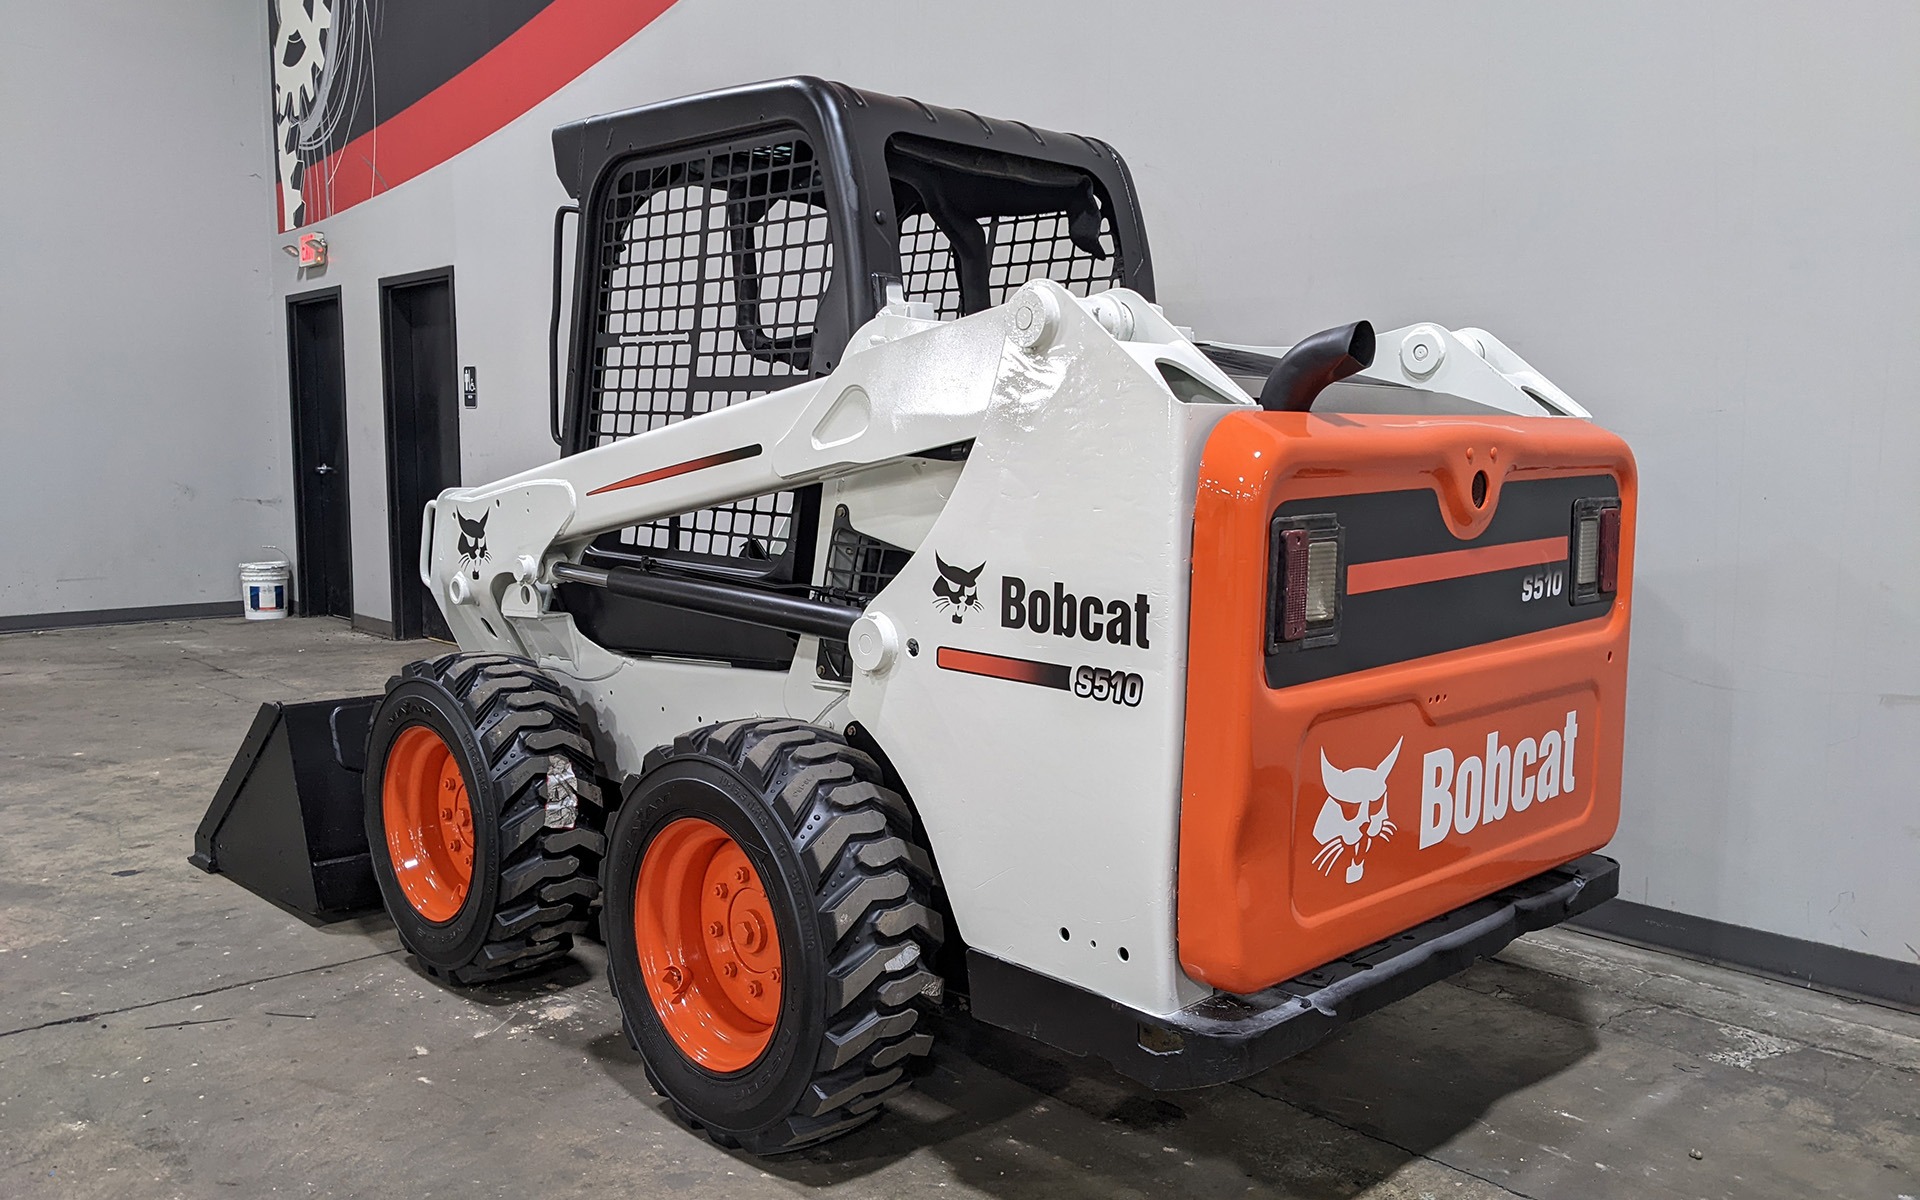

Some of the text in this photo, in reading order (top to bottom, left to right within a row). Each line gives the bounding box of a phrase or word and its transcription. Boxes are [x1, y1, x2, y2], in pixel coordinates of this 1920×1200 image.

[1001, 575, 1150, 650] Bobcat
[1521, 570, 1563, 602] S510
[1075, 665, 1144, 707] S510
[1419, 709, 1578, 850] Bobcat
